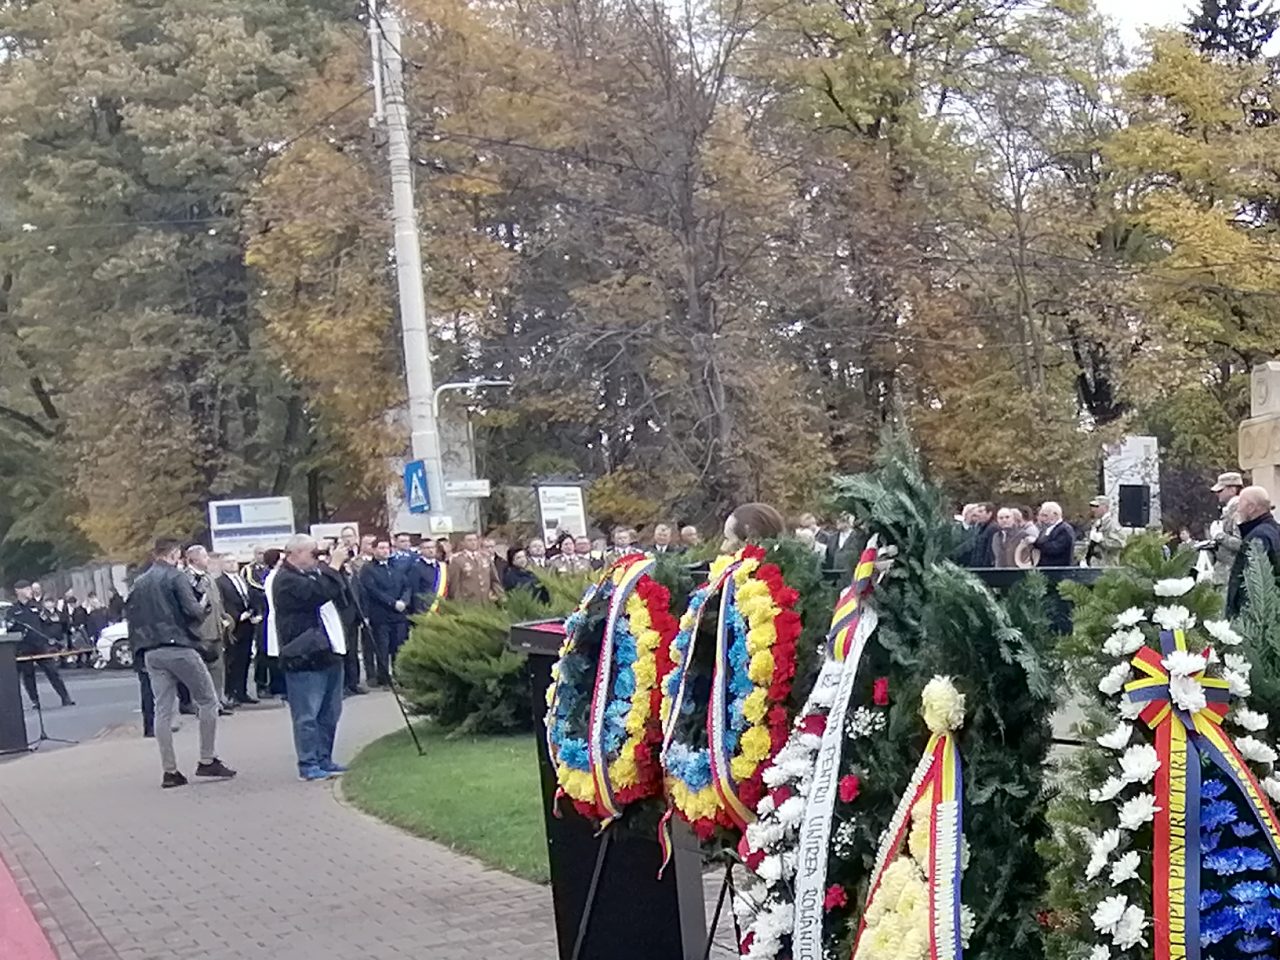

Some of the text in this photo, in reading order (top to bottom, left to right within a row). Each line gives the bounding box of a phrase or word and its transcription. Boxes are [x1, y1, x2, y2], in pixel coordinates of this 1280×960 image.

[814, 746, 836, 804] PENTRU
[804, 817, 824, 878] UNIREA
[1168, 801, 1186, 880] PENTRU
[1168, 886, 1186, 946] LUPTA
